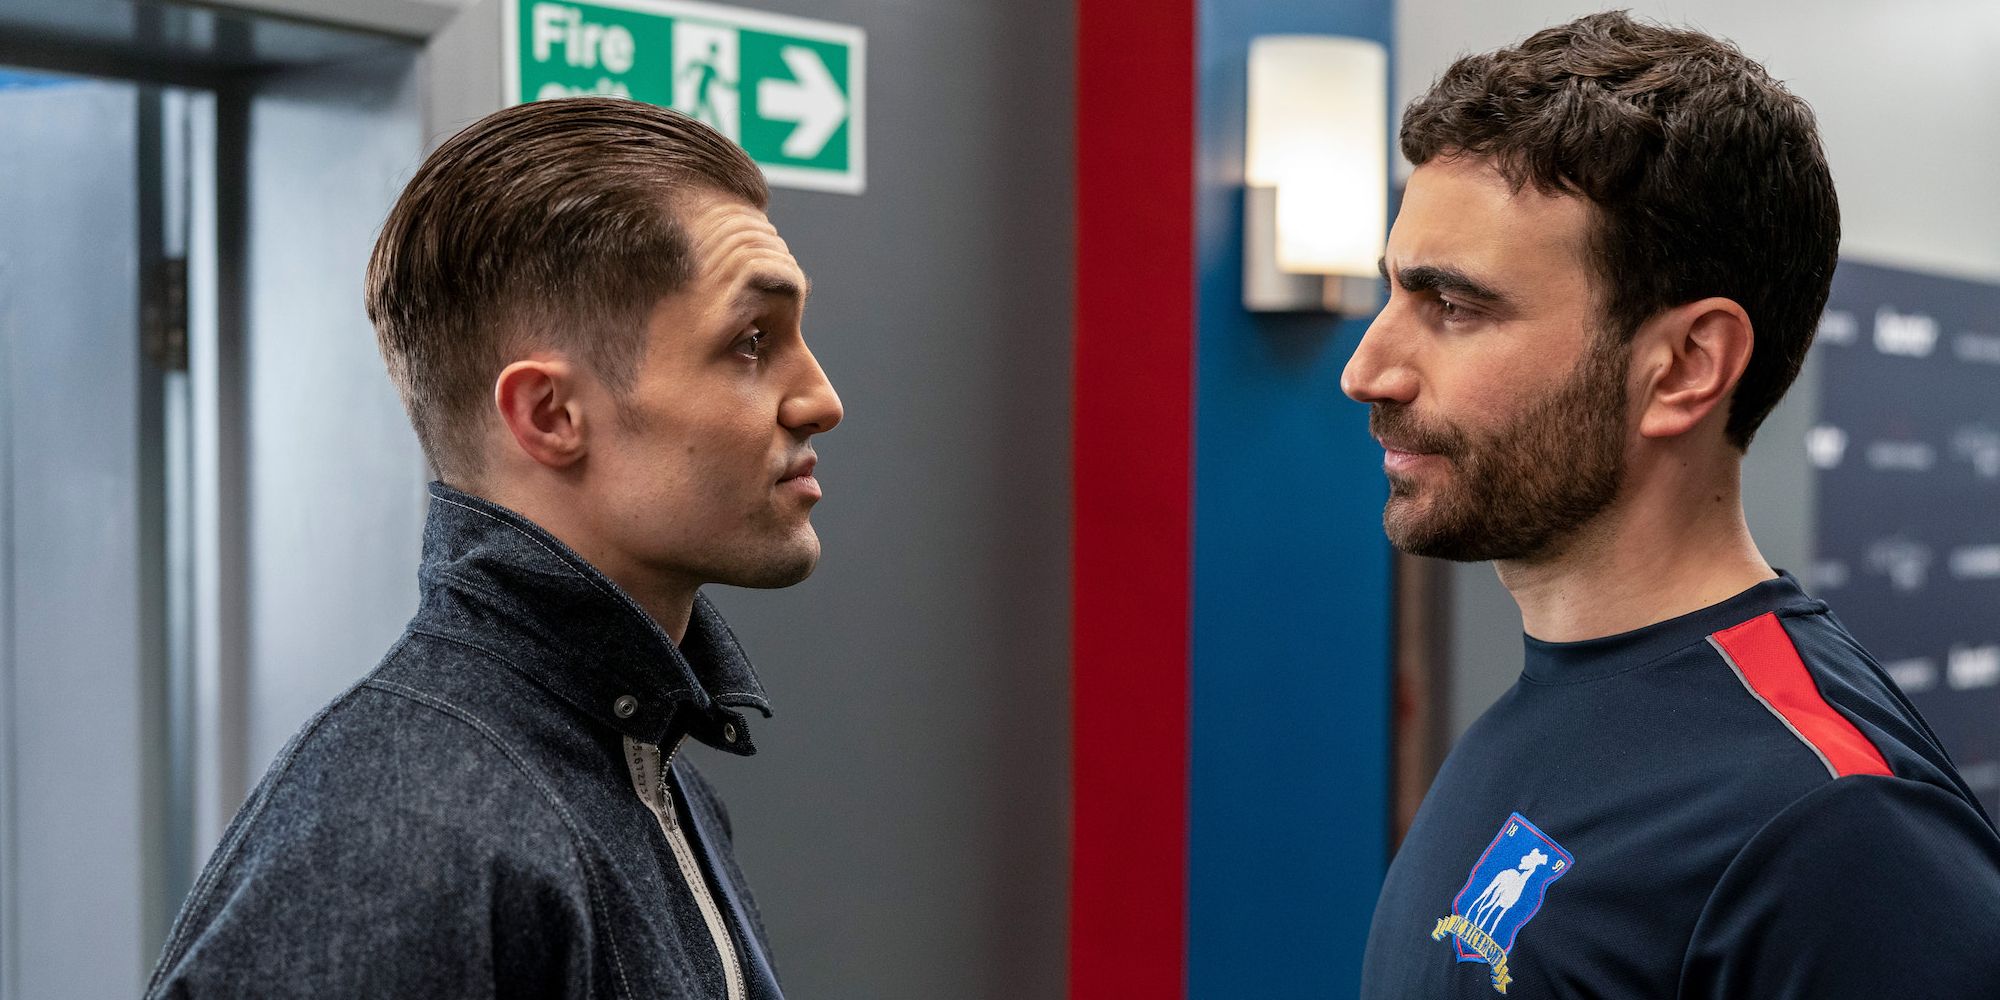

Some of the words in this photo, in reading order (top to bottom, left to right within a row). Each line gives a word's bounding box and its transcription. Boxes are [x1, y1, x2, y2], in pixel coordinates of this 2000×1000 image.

[533, 3, 635, 74] Fire
[1506, 823, 1519, 837] 18
[1551, 859, 1566, 873] 97
